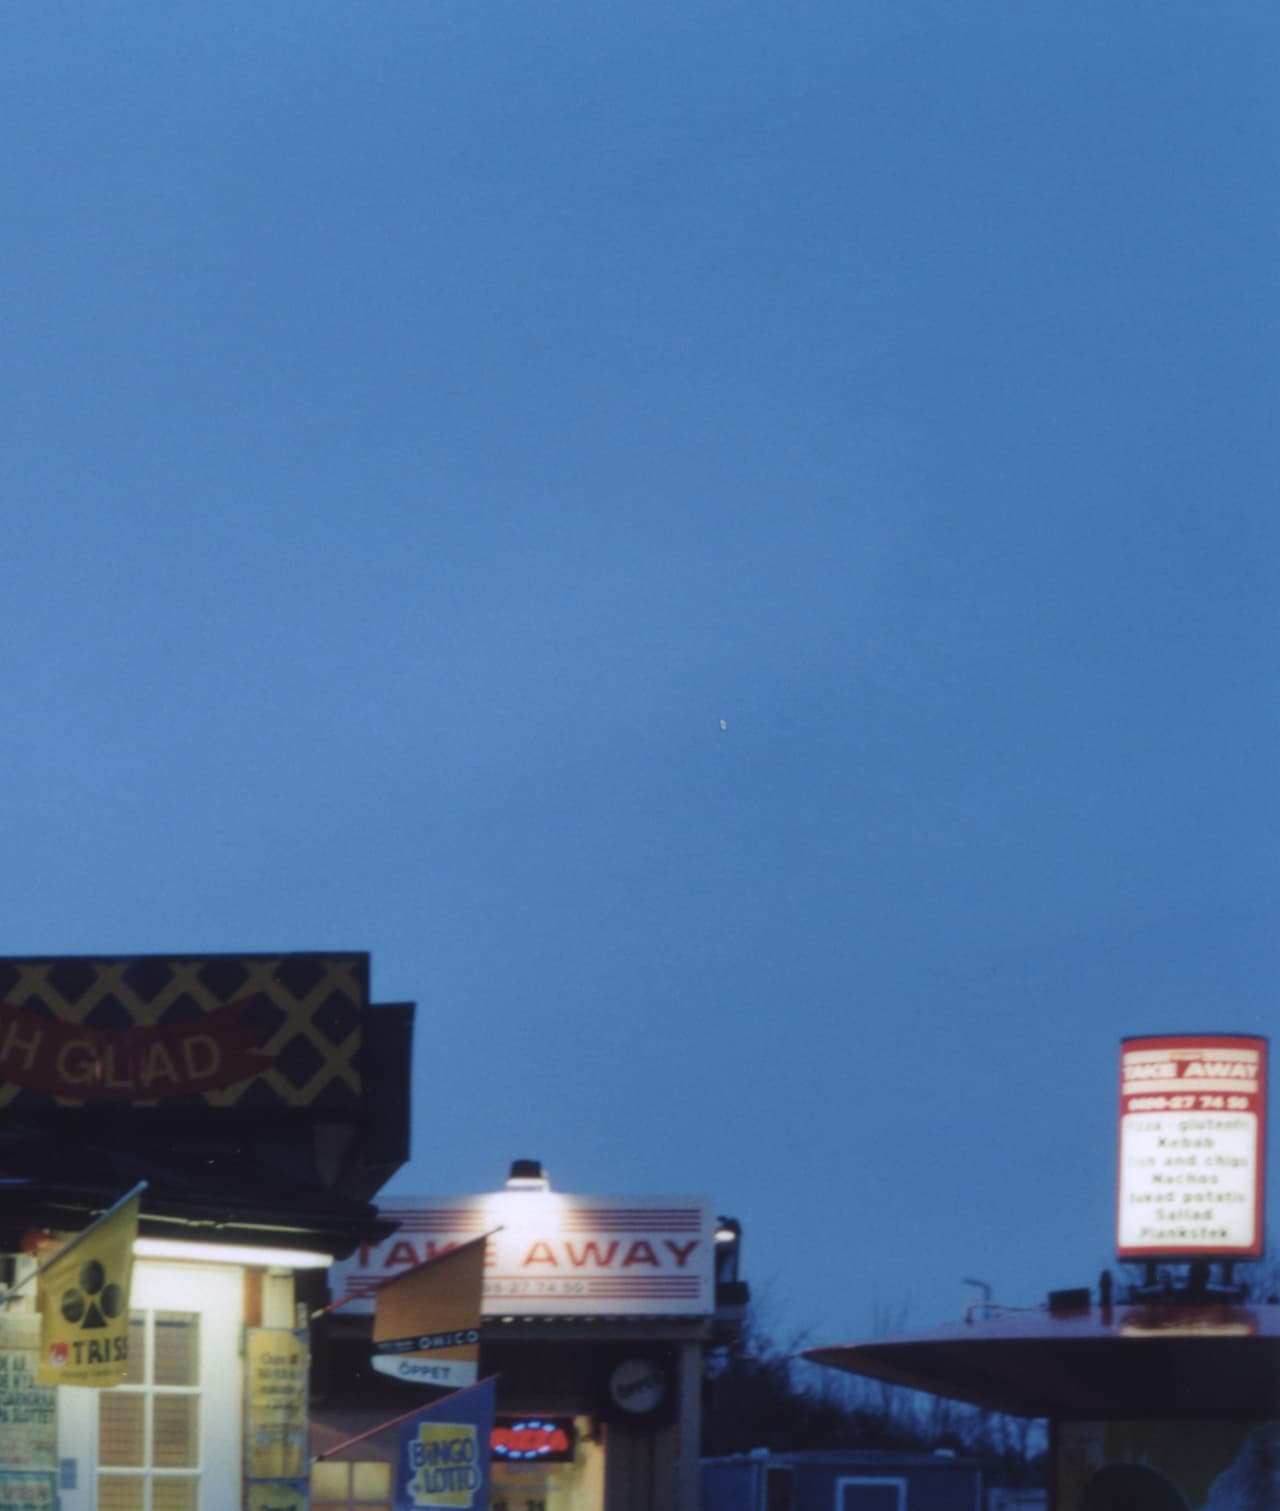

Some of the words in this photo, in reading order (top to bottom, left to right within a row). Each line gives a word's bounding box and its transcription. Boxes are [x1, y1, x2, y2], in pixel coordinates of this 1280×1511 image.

[58, 1035, 221, 1089] GLAD
[1182, 1062, 1259, 1079] AWAY
[1157, 1136, 1215, 1149] Kebab
[1152, 1172, 1220, 1185] Nachos
[523, 1239, 701, 1268] AWAY
